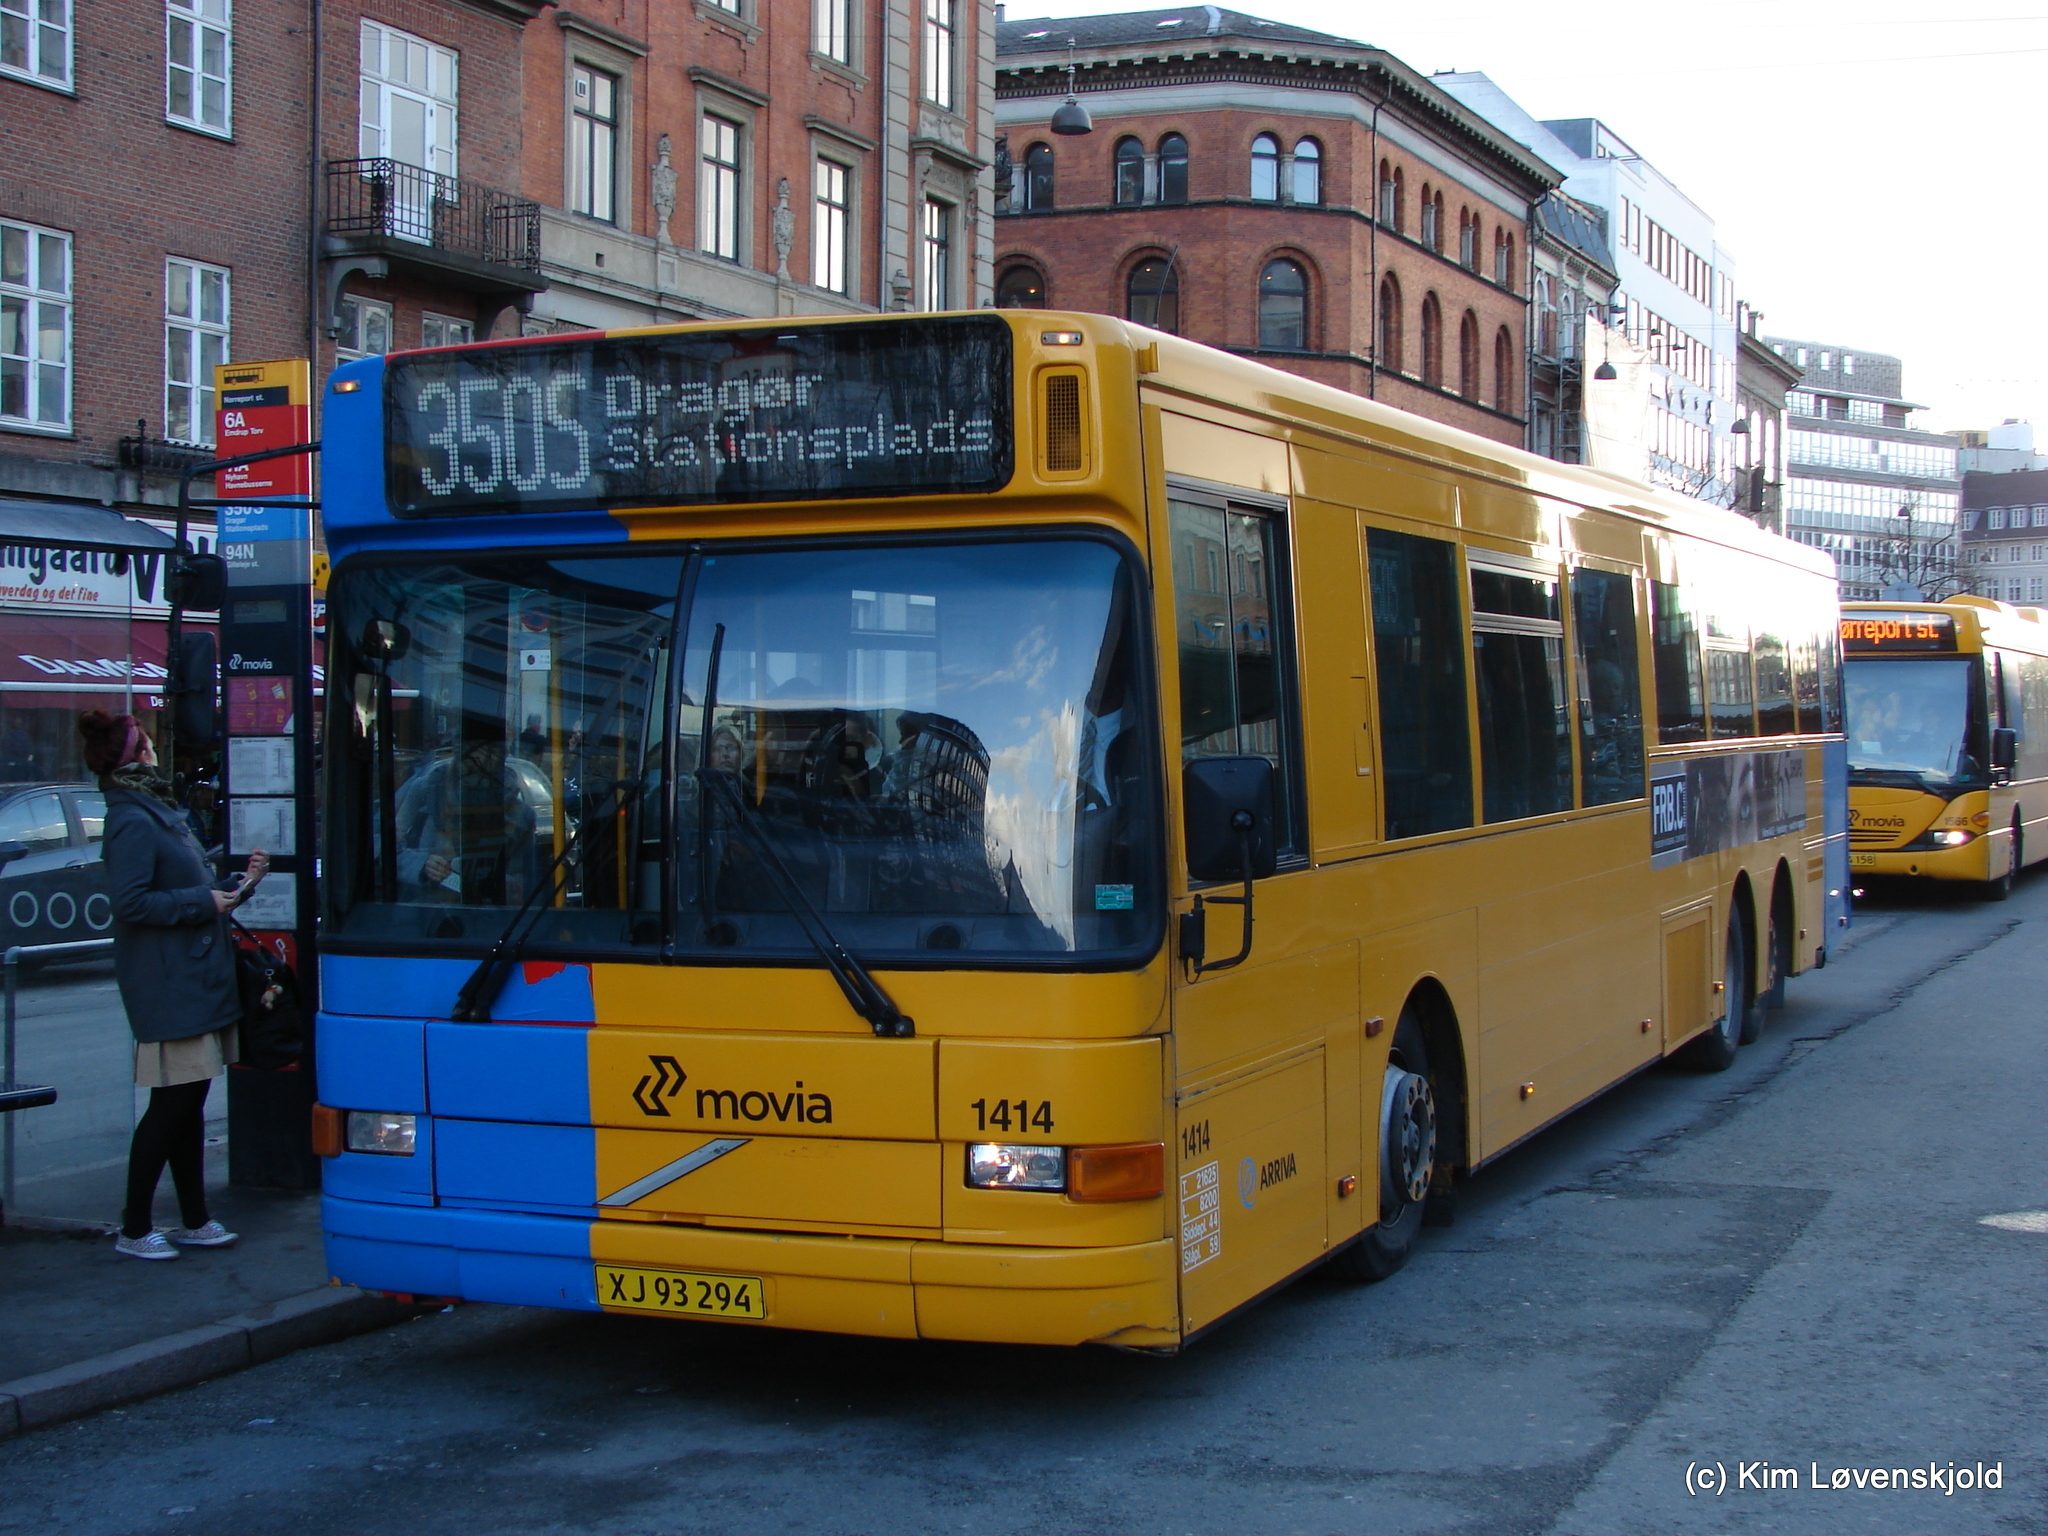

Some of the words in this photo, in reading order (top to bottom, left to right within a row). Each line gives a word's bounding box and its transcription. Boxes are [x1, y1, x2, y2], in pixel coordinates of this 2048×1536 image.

[605, 373, 823, 420] Dragør
[224, 411, 246, 429] 6A
[224, 429, 249, 437] Emdrup
[250, 427, 264, 435] Torv
[418, 372, 591, 496] 350S
[607, 408, 994, 470] Stationsplads
[224, 473, 248, 482] Nyhavn
[225, 543, 255, 560] 94N
[42, 588, 55, 603] og
[58, 586, 76, 600] det
[78, 587, 99, 602] fine
[1916, 614, 1939, 639] st.
[243, 658, 273, 670] movia
[1862, 815, 1905, 827] movia
[695, 1080, 833, 1124] movia
[971, 1097, 1055, 1134] 1414
[1181, 1119, 1211, 1160] 1414
[1260, 1152, 1297, 1191] ARRIVA
[1200, 1188, 1218, 1212] 8200
[1208, 1210, 1219, 1229] 44
[1209, 1234, 1219, 1254] 59
[608, 1272, 647, 1303] XJ
[653, 1278, 690, 1308] 93
[696, 1280, 752, 1313] 294
